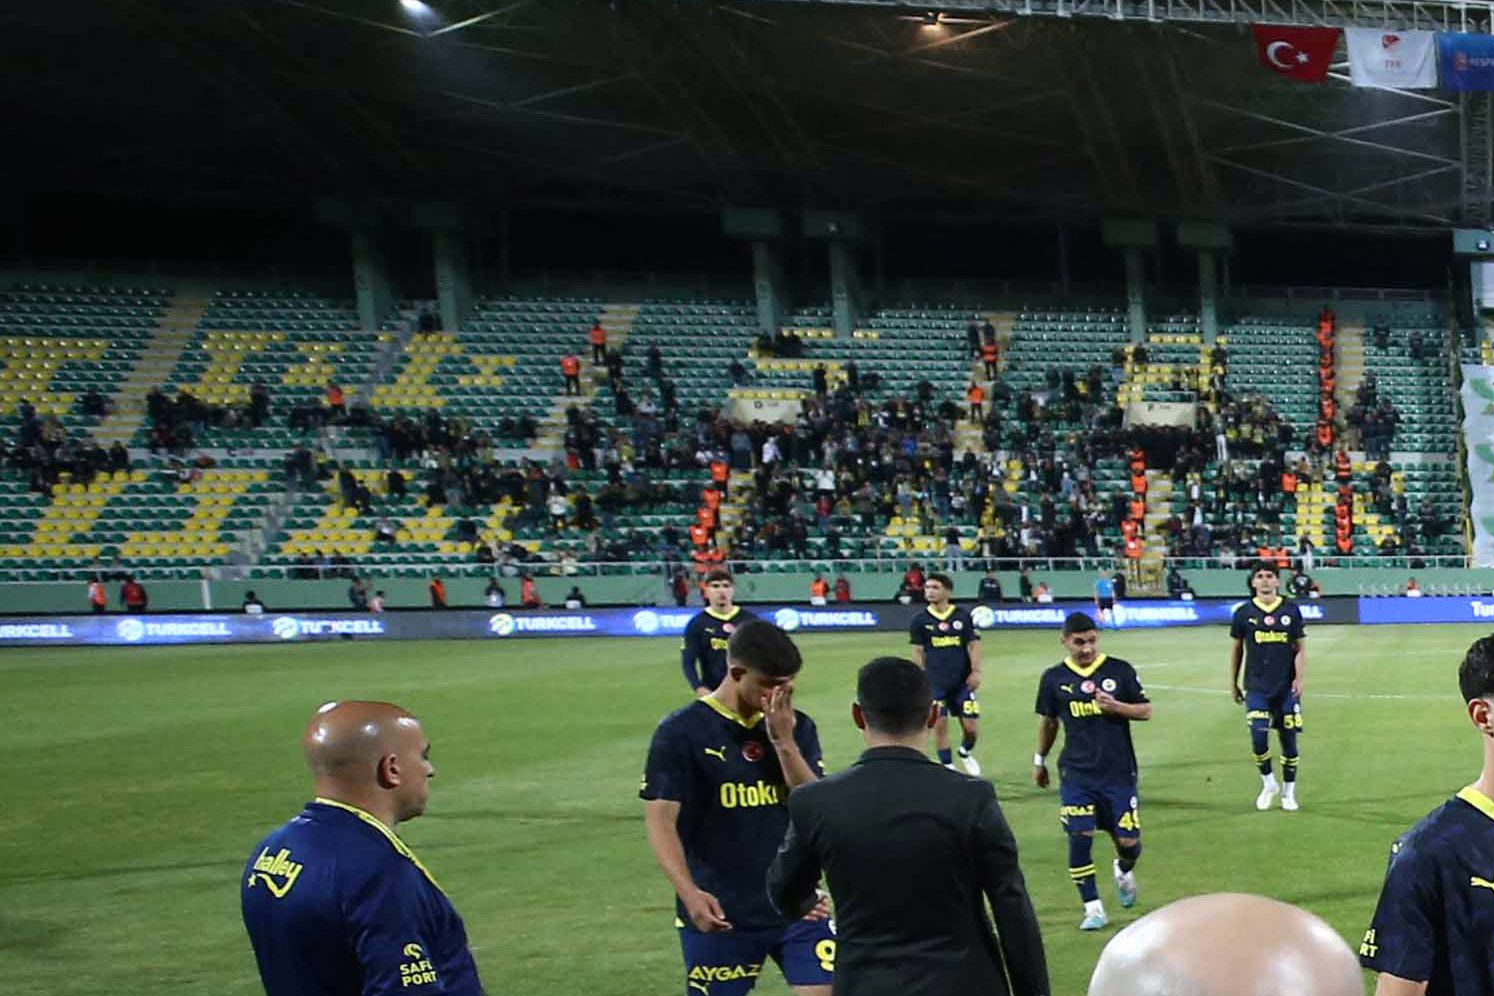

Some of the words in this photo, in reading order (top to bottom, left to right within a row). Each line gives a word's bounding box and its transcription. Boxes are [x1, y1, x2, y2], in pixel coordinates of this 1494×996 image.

[515, 616, 597, 630] TURKCELL
[800, 611, 877, 626] TURKCELL
[995, 609, 1065, 623] TURKCELL
[145, 621, 232, 636] TURKCELL
[402, 970, 437, 987] PORT
